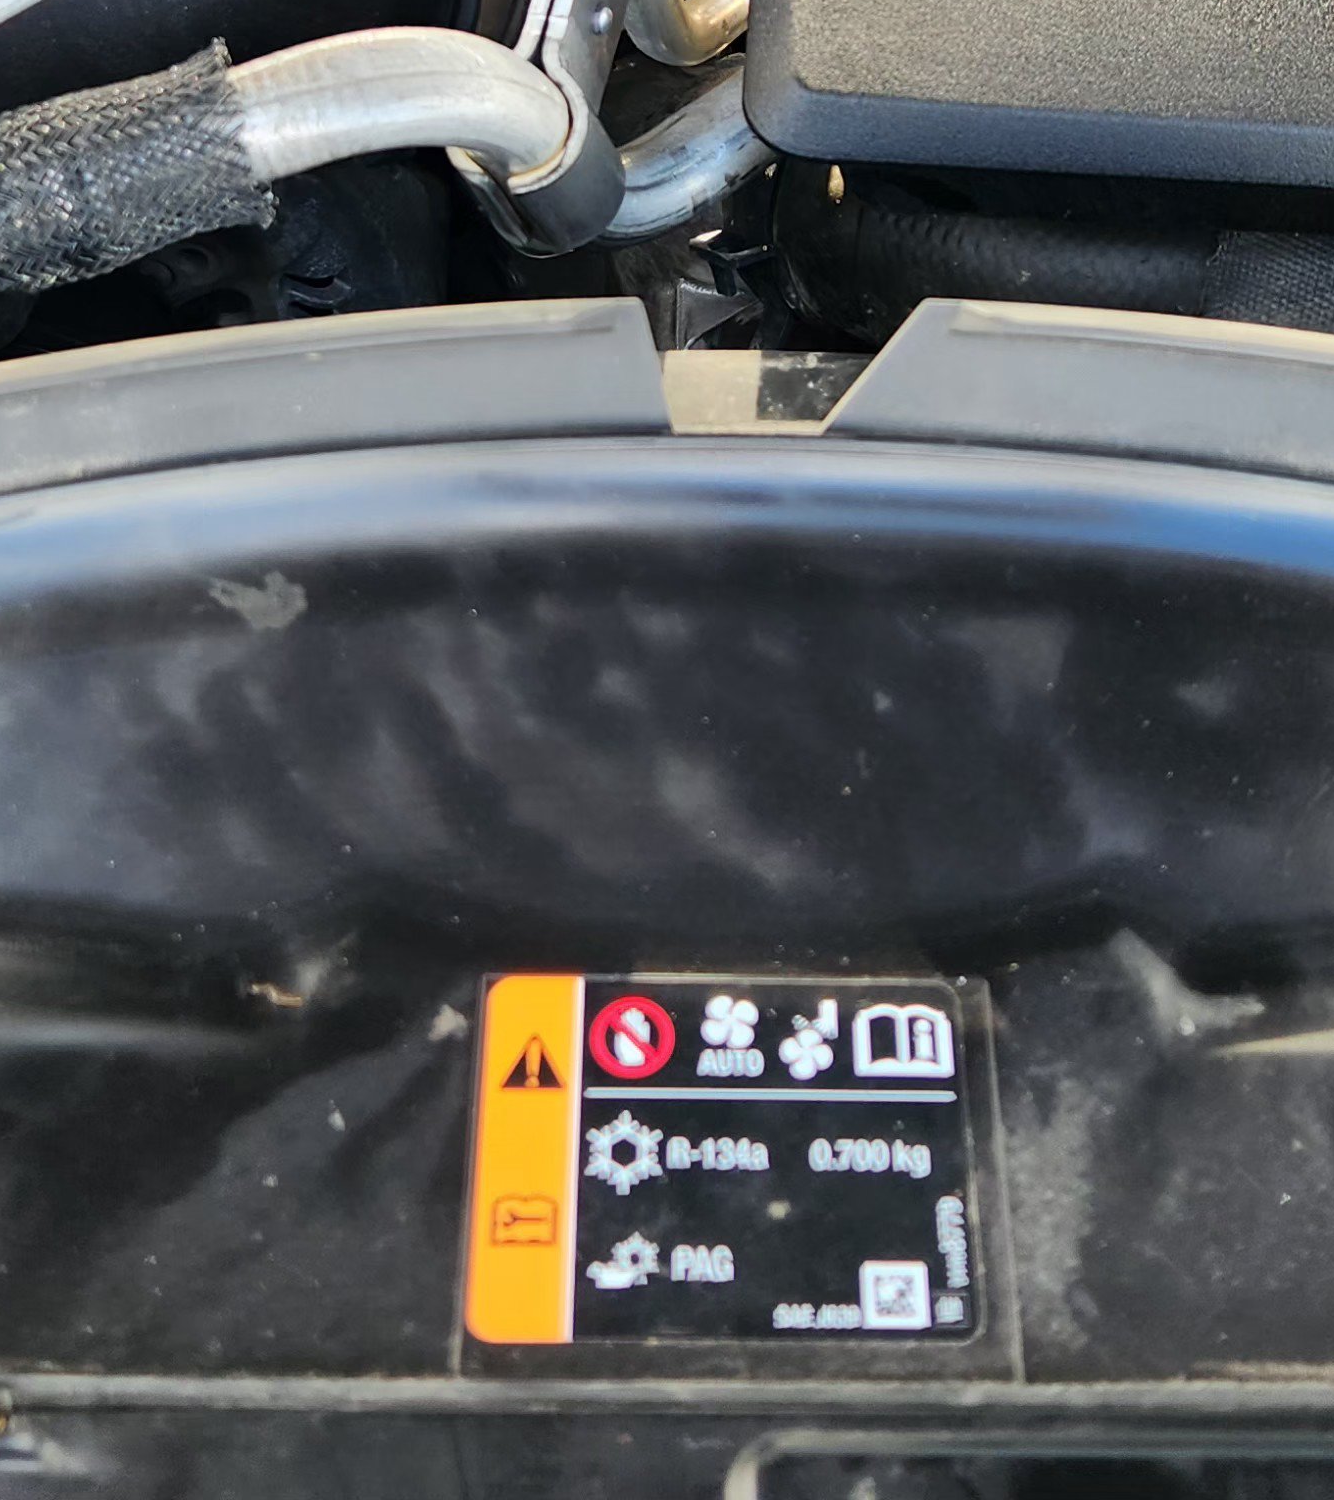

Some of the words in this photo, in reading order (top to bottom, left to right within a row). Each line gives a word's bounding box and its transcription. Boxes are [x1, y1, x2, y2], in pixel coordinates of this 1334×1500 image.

[697, 1048, 765, 1078] AUTO
[667, 1134, 769, 1171] R-134a
[808, 1138, 890, 1172] 0.700
[891, 1139, 931, 1179] kg
[671, 1243, 734, 1283] PAG
